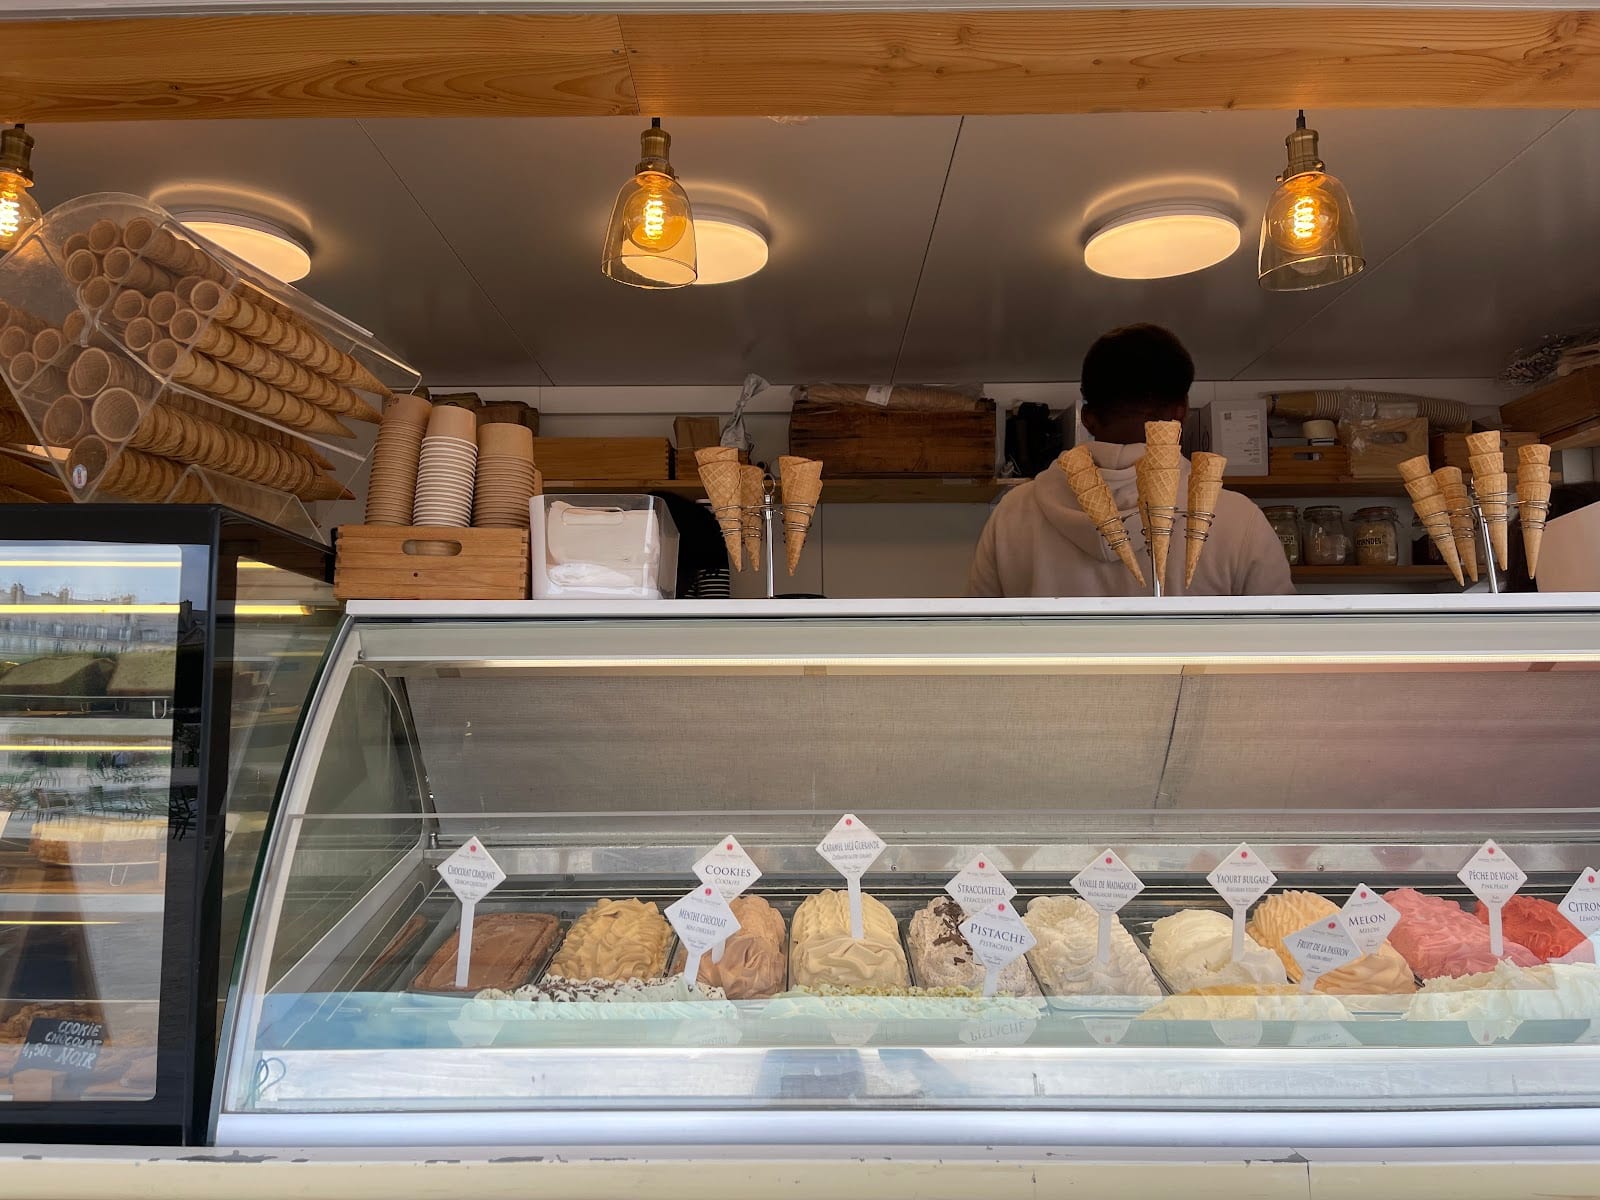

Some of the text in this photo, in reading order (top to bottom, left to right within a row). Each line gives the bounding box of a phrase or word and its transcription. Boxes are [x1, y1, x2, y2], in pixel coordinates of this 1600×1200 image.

[705, 864, 751, 877] COOKIES
[1490, 871, 1499, 881] DE
[1499, 871, 1519, 881] VIGNE
[1098, 880, 1105, 889] DE
[1106, 880, 1137, 891] MADAGASCAR
[1216, 873, 1241, 884] YAOURT
[957, 882, 1006, 896] STRACCIATELLA
[1348, 913, 1386, 927] MELON
[970, 922, 1026, 945] PISTACHE
[59, 1021, 102, 1037] COOKIE
[45, 1031, 103, 1049] CHOCOLAT
[55, 1047, 97, 1069] NOIR
